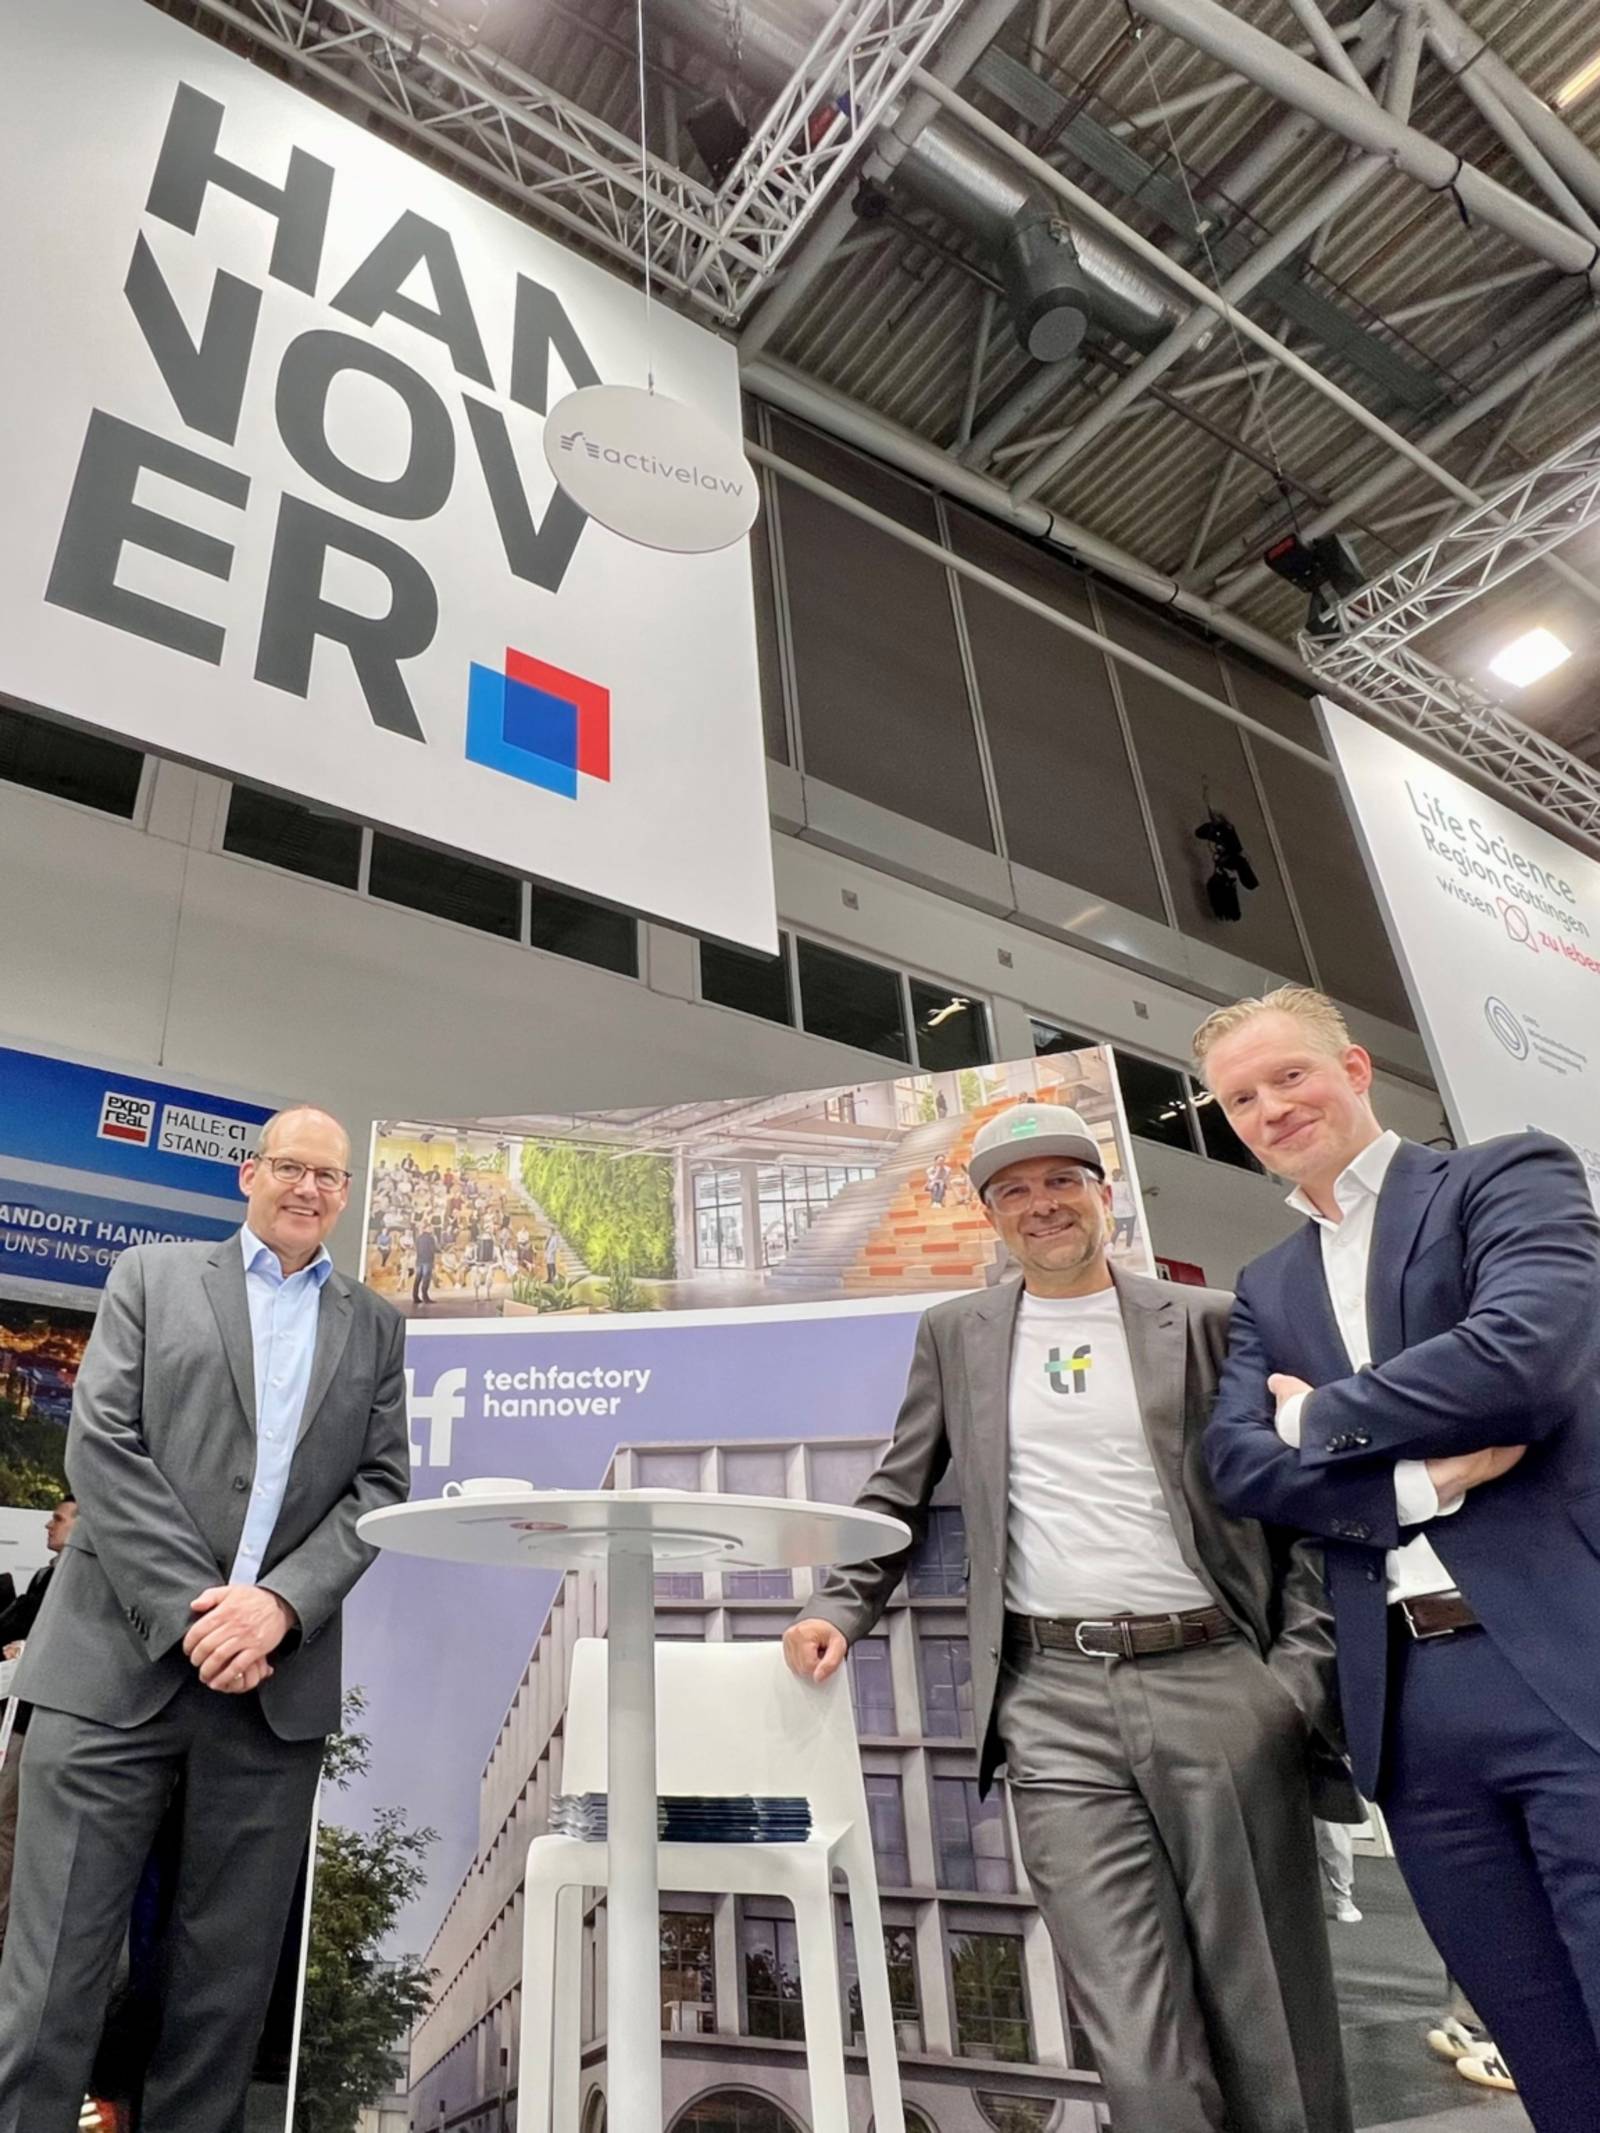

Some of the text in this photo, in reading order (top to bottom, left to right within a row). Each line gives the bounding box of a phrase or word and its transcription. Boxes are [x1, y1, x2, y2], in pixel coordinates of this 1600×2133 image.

[603, 447, 744, 497] activelaw
[44, 407, 439, 744] ER
[1405, 780, 1576, 904] Life Science
[1421, 823, 1590, 938] Region Göttingen
[1437, 875, 1498, 919] wissen
[108, 1096, 150, 1115] expo
[166, 1110, 246, 1141] HALLE: C1
[163, 1132, 224, 1159] STAND:
[5, 1232, 49, 1257] UNS
[55, 1241, 90, 1264] INS
[483, 1365, 652, 1394] techfactory
[1044, 1344, 1092, 1394] tf
[483, 1394, 622, 1418] hannover
